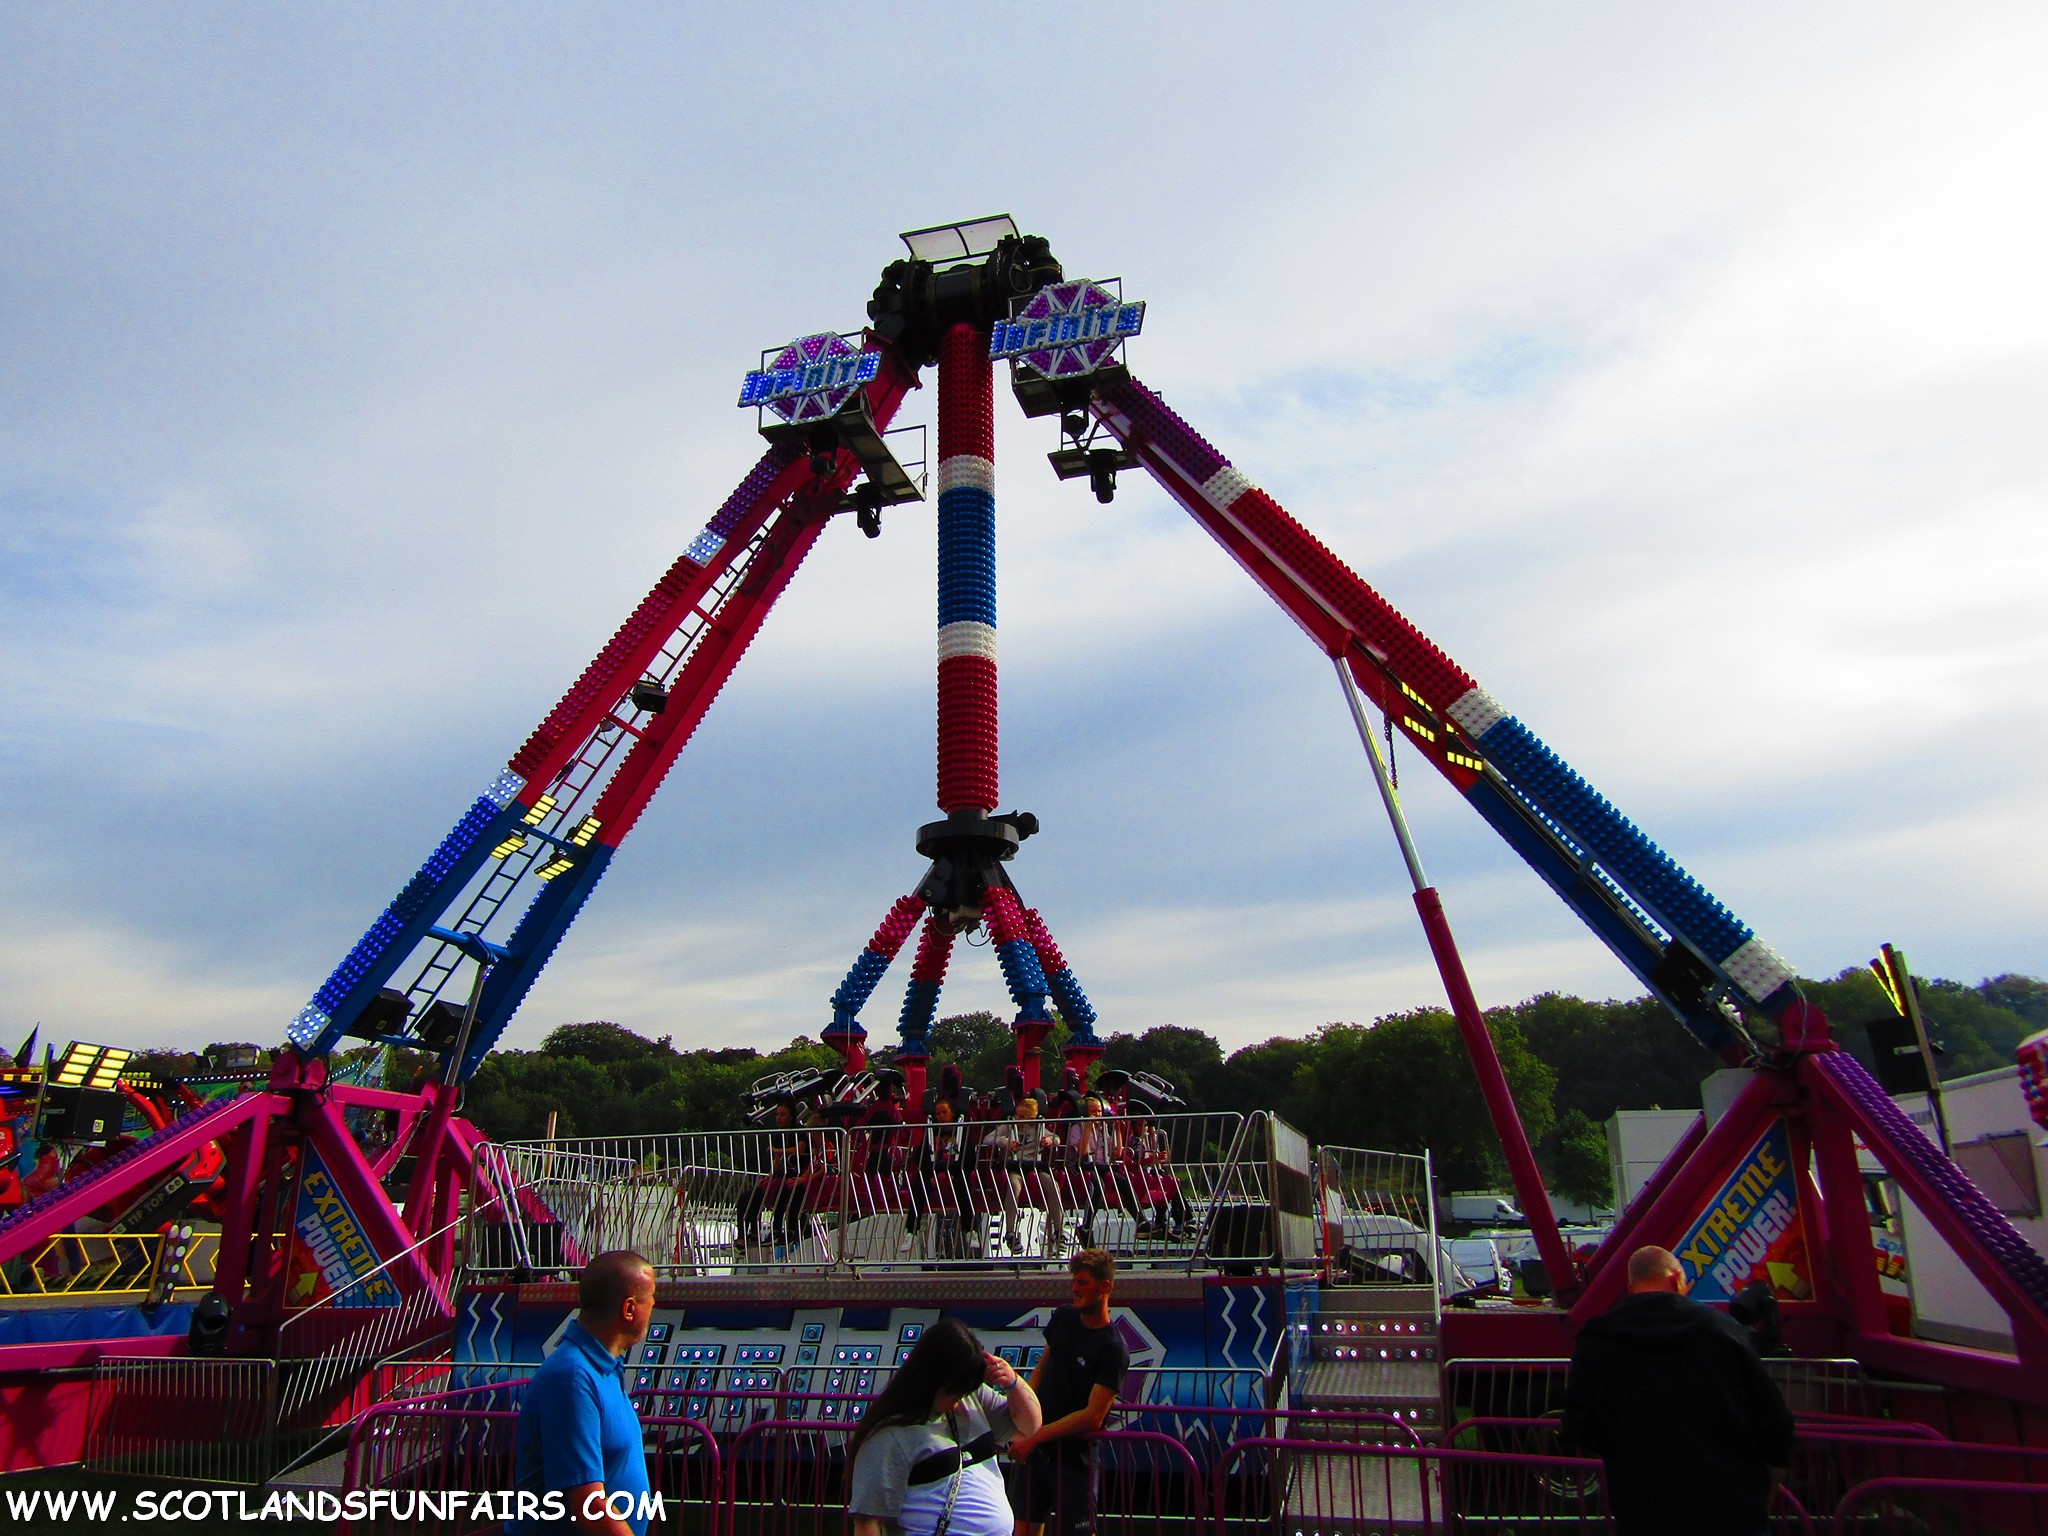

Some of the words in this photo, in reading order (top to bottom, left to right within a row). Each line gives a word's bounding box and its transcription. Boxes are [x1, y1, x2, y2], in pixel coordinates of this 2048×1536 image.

[303, 1170, 393, 1304] EXTREME
[1680, 1140, 1787, 1293] XTREME
[1711, 1189, 1798, 1297] POWER!
